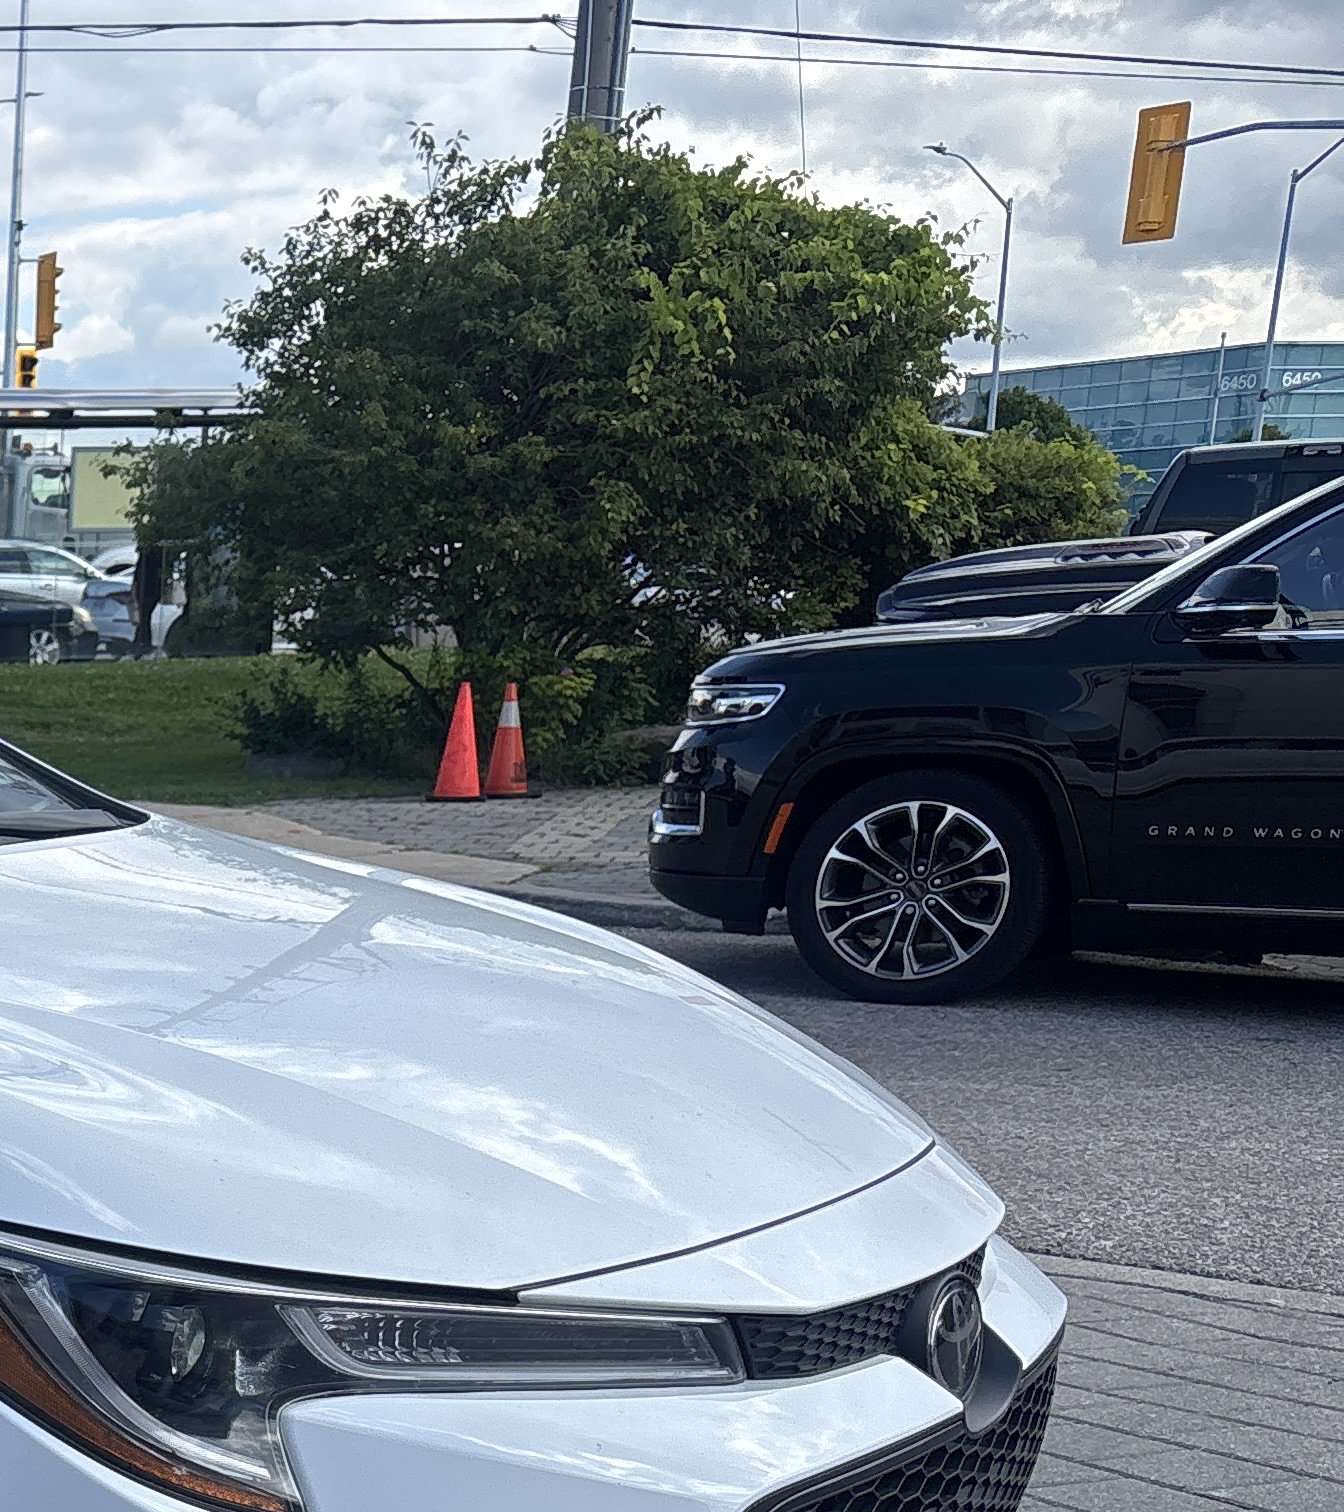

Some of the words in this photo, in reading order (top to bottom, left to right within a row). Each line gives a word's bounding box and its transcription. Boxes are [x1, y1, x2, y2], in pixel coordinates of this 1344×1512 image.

[1220, 373, 1257, 391] 6450
[1147, 825, 1234, 838] GRAND
[1253, 826, 1344, 840] WAGON
